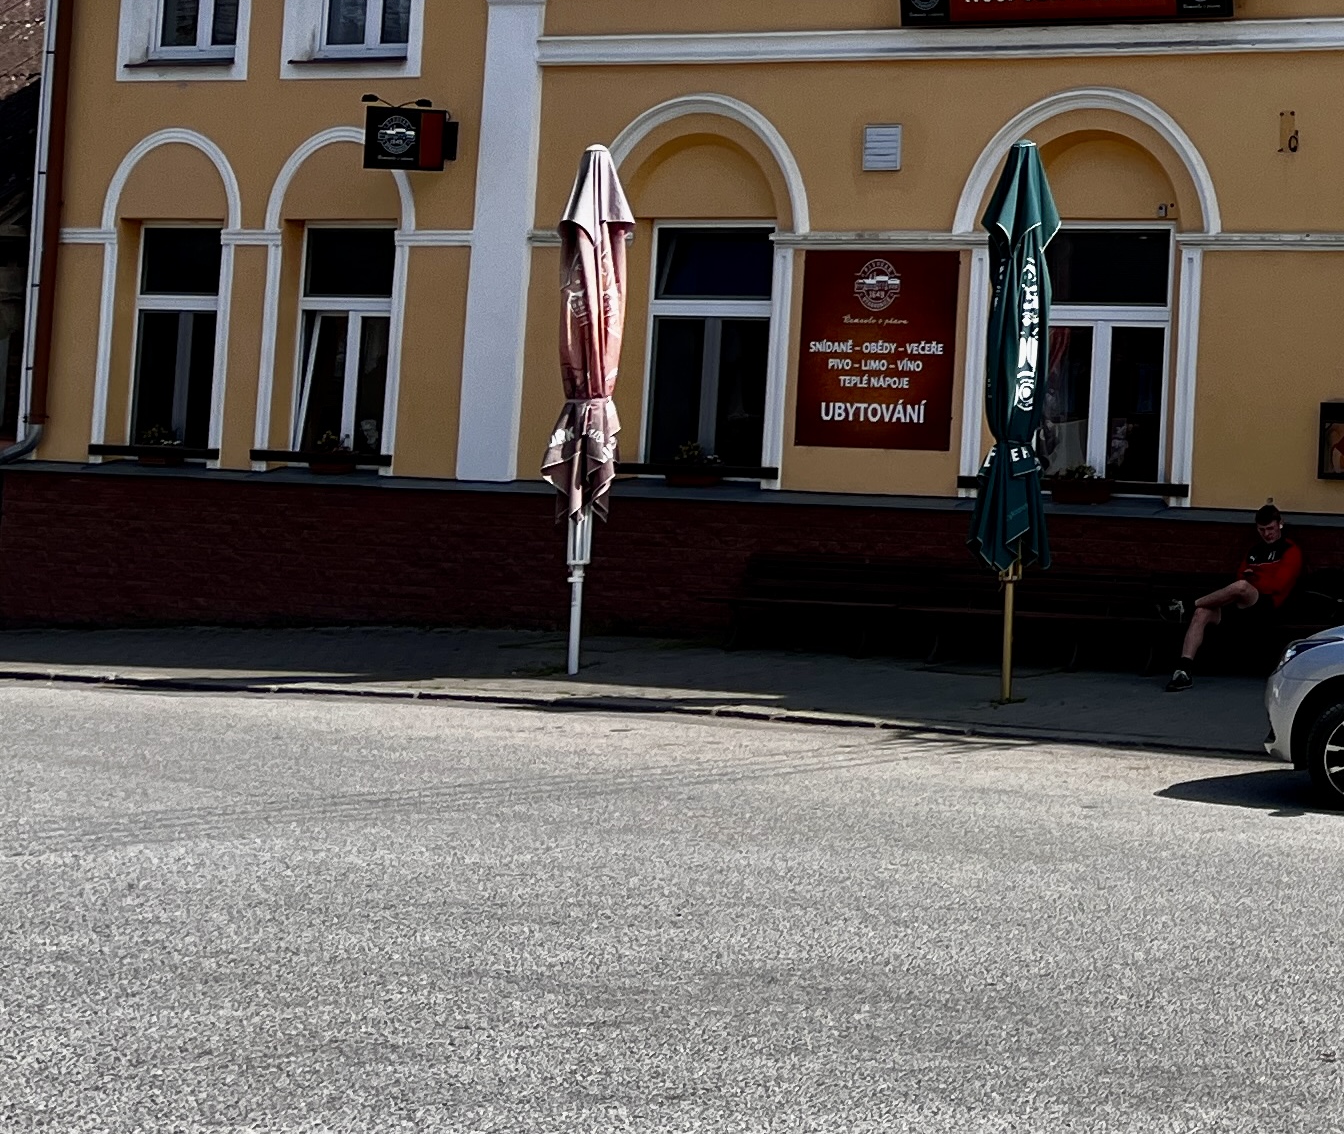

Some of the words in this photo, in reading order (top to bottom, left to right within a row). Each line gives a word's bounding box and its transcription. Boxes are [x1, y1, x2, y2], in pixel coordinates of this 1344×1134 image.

[809, 339, 853, 353] SNÍDANĚ
[862, 340, 897, 354] OBĚDY
[906, 340, 944, 355] VEČEŘE
[828, 358, 852, 370] PIVO
[861, 359, 887, 371] LIMO
[897, 357, 923, 372] VÍNO
[839, 374, 869, 388] TEPLÉ
[870, 374, 910, 389] NÁPOJE
[820, 399, 927, 423] UBYTOVÁNÍ
